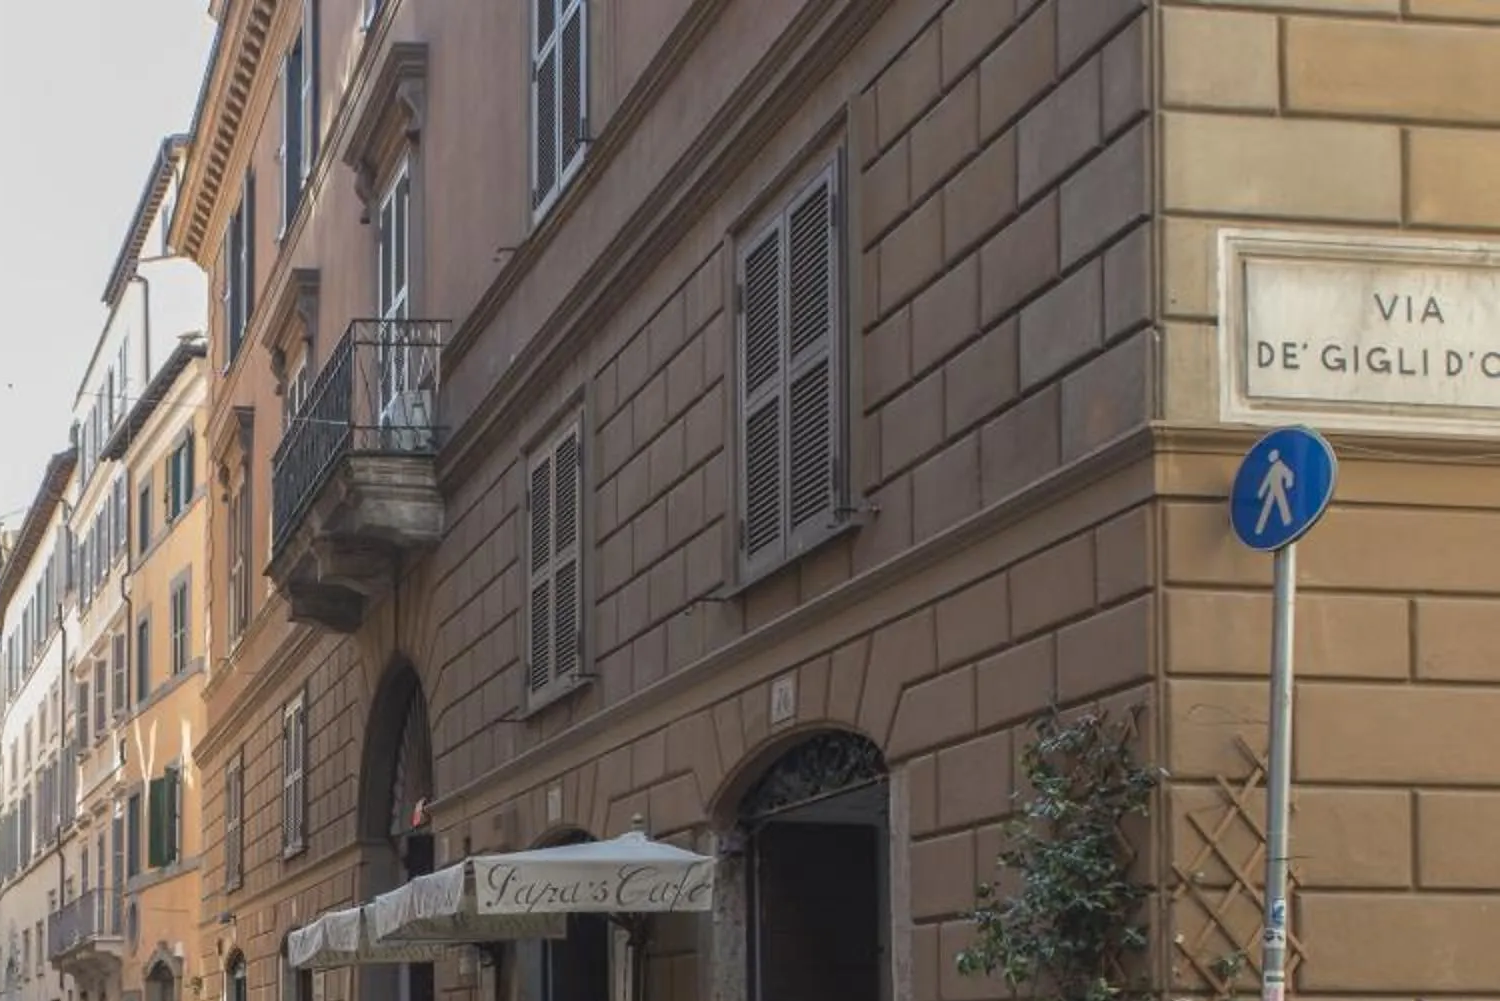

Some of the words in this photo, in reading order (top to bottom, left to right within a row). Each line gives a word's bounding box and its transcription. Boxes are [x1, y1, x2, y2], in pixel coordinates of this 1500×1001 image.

[1373, 293, 1445, 325] VIA
[1257, 341, 1309, 370] DE'
[1320, 344, 1430, 376] GIGLI
